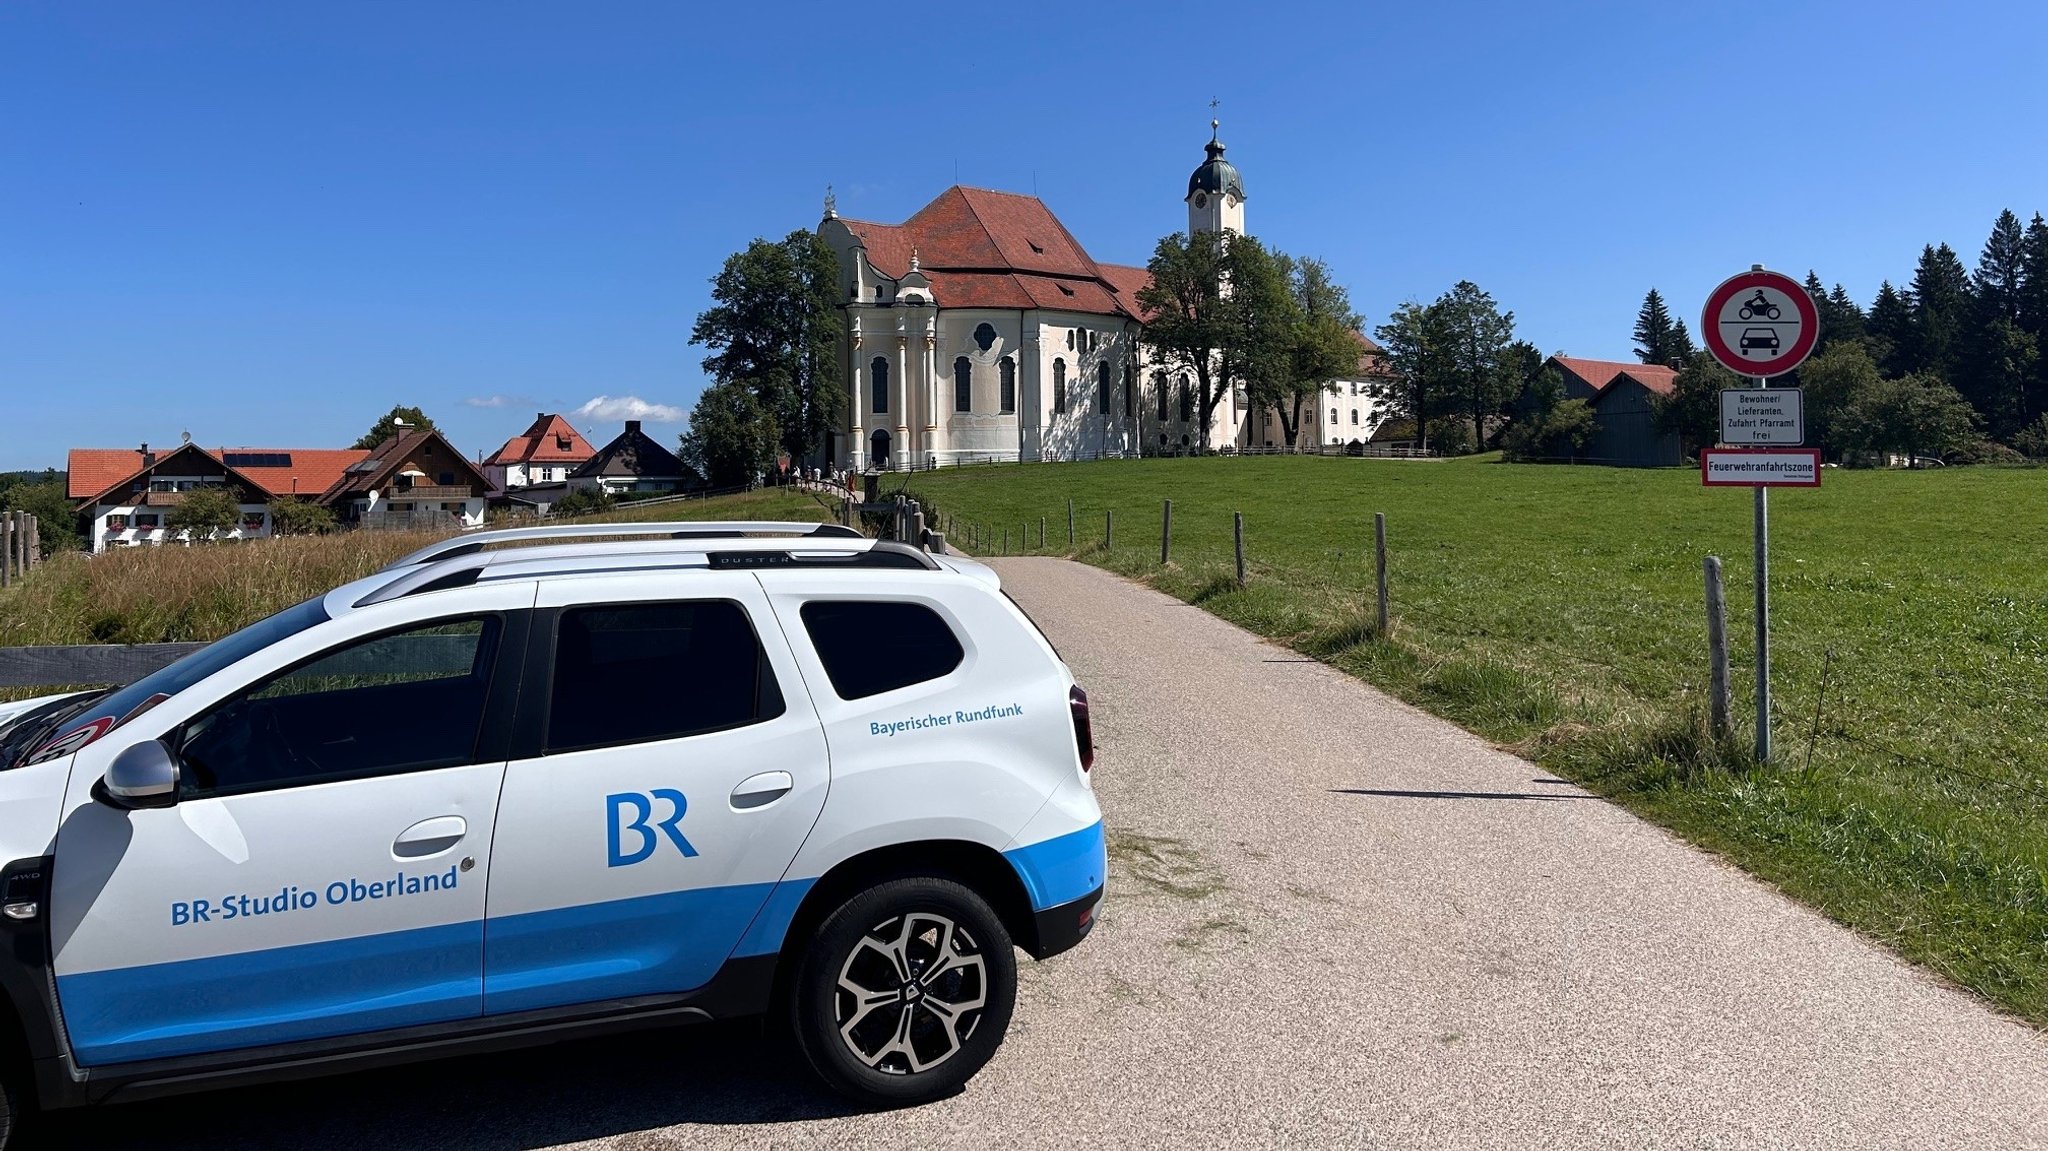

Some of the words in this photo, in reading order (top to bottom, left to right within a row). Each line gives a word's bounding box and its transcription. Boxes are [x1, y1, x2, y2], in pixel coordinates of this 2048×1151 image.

[1740, 394, 1781, 404] Bewohner/
[1728, 418, 1757, 428] Zufahrt
[1760, 418, 1795, 428] Pfarramt
[1753, 431, 1771, 440] frei
[1708, 461, 1813, 472] Feuerwehranfahrtszone
[721, 556, 789, 564] DUSTER
[870, 714, 952, 737] Bayerischer
[955, 703, 1023, 723] Rundfunk
[606, 788, 700, 868] BR
[11, 872, 41, 881] 4WD
[172, 887, 318, 926] BR-Studio
[326, 865, 458, 905] Oberland
